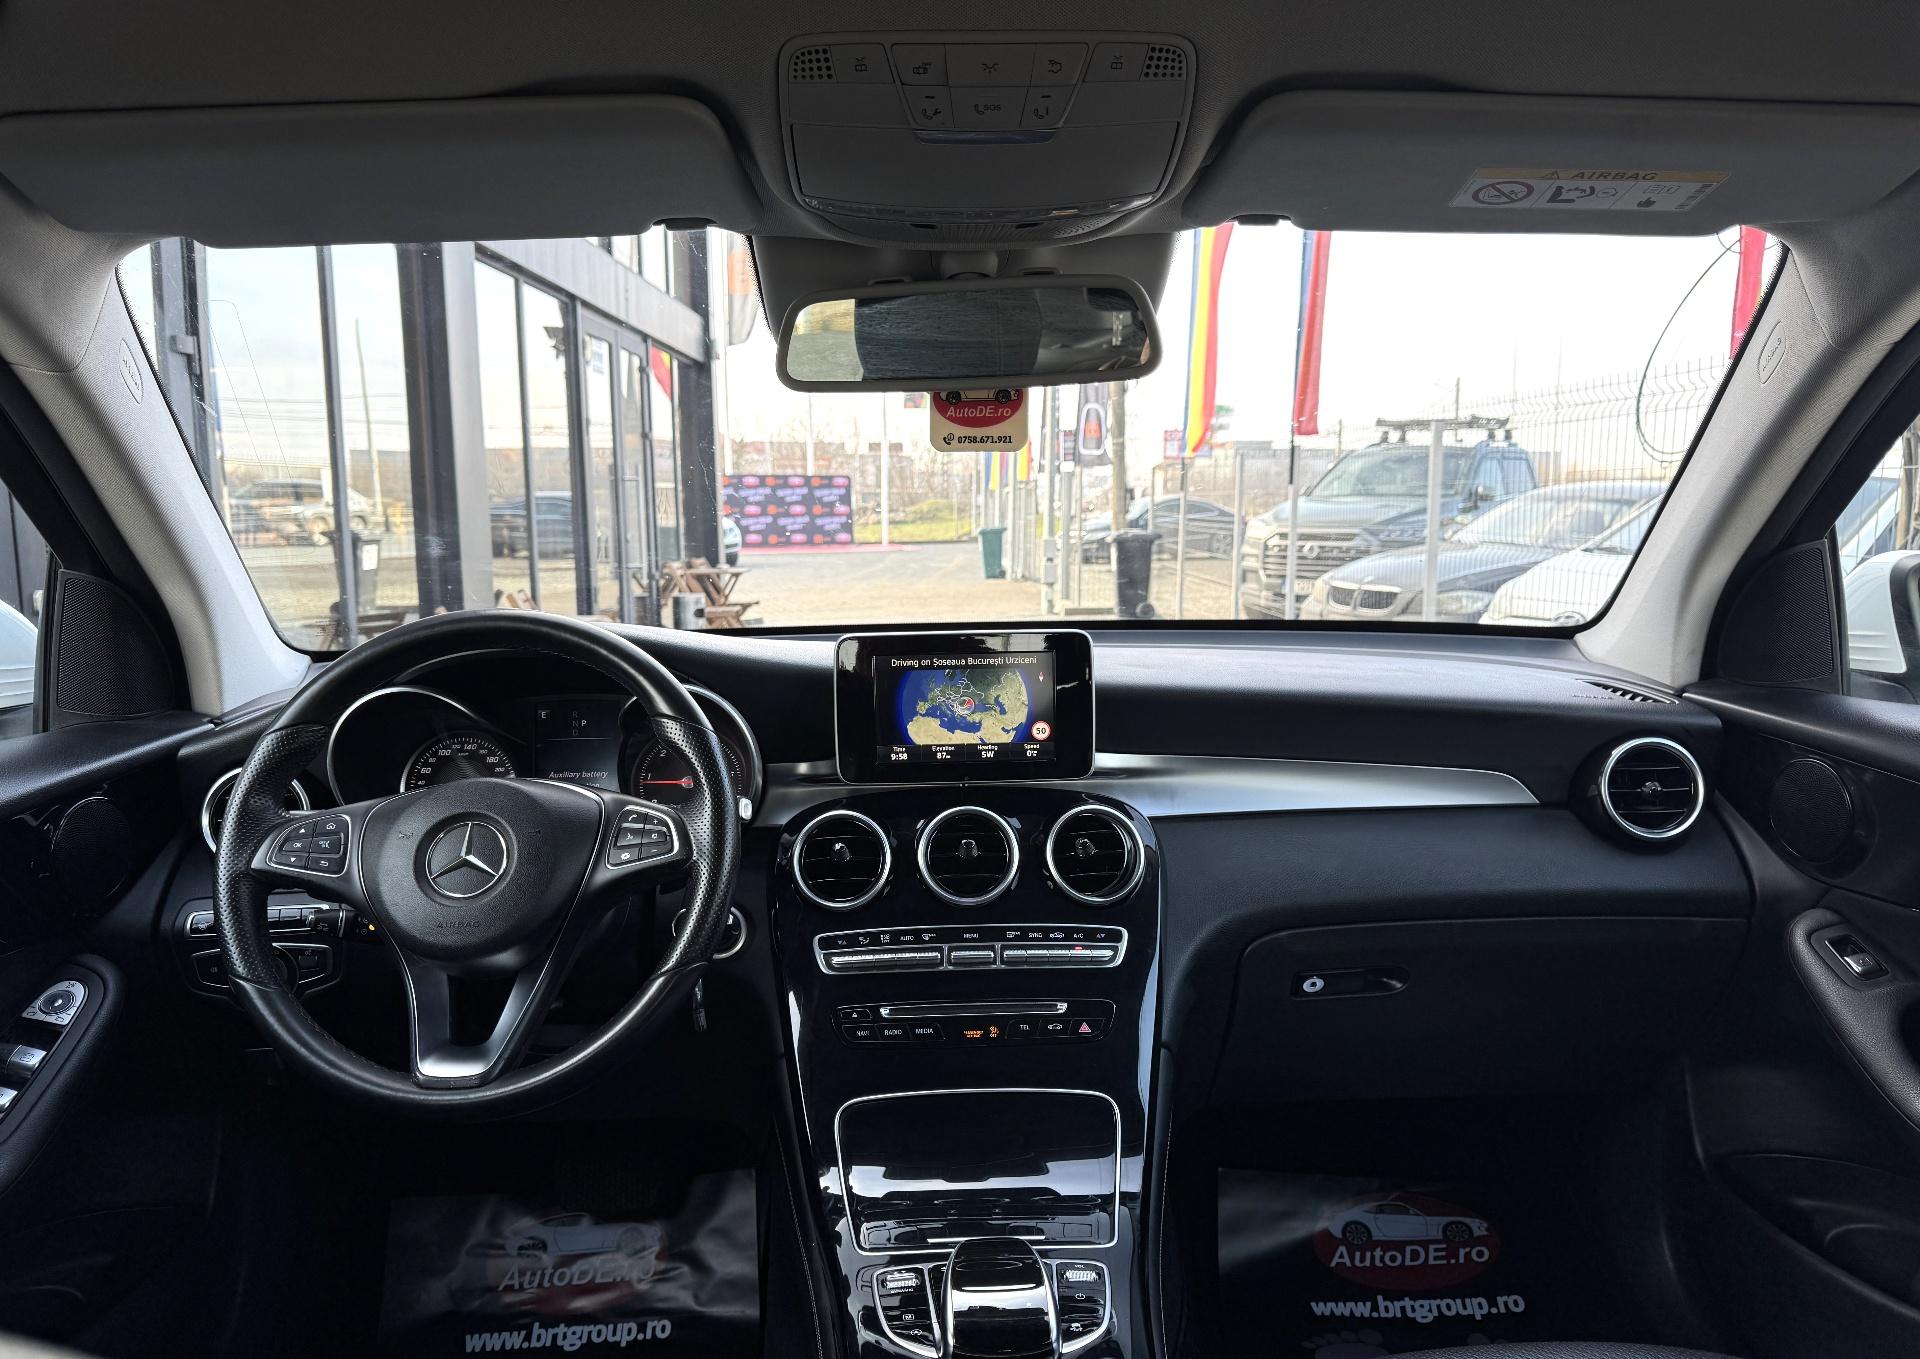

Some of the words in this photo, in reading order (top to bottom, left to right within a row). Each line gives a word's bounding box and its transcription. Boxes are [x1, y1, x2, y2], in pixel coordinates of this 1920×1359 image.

[1571, 171, 1659, 180] AIRBAG
[946, 405, 1011, 417] AutoDE.ro
[957, 435, 1012, 444] 0758.671.921
[891, 658, 919, 668] Driving
[933, 657, 966, 668] Șoseaua
[967, 656, 1004, 667] București
[1005, 655, 1037, 665] Urziceni
[541, 711, 547, 719] E
[581, 719, 587, 727] P
[1036, 727, 1046, 735] 50
[981, 750, 995, 758] SW
[548, 771, 581, 780] Auxiliary
[582, 770, 609, 779] battery
[1329, 1244, 1490, 1268] AutoDE.ro
[1309, 1294, 1526, 1324] www.brtgroup.ro
[464, 1319, 673, 1353] www.brtgroup.ro
